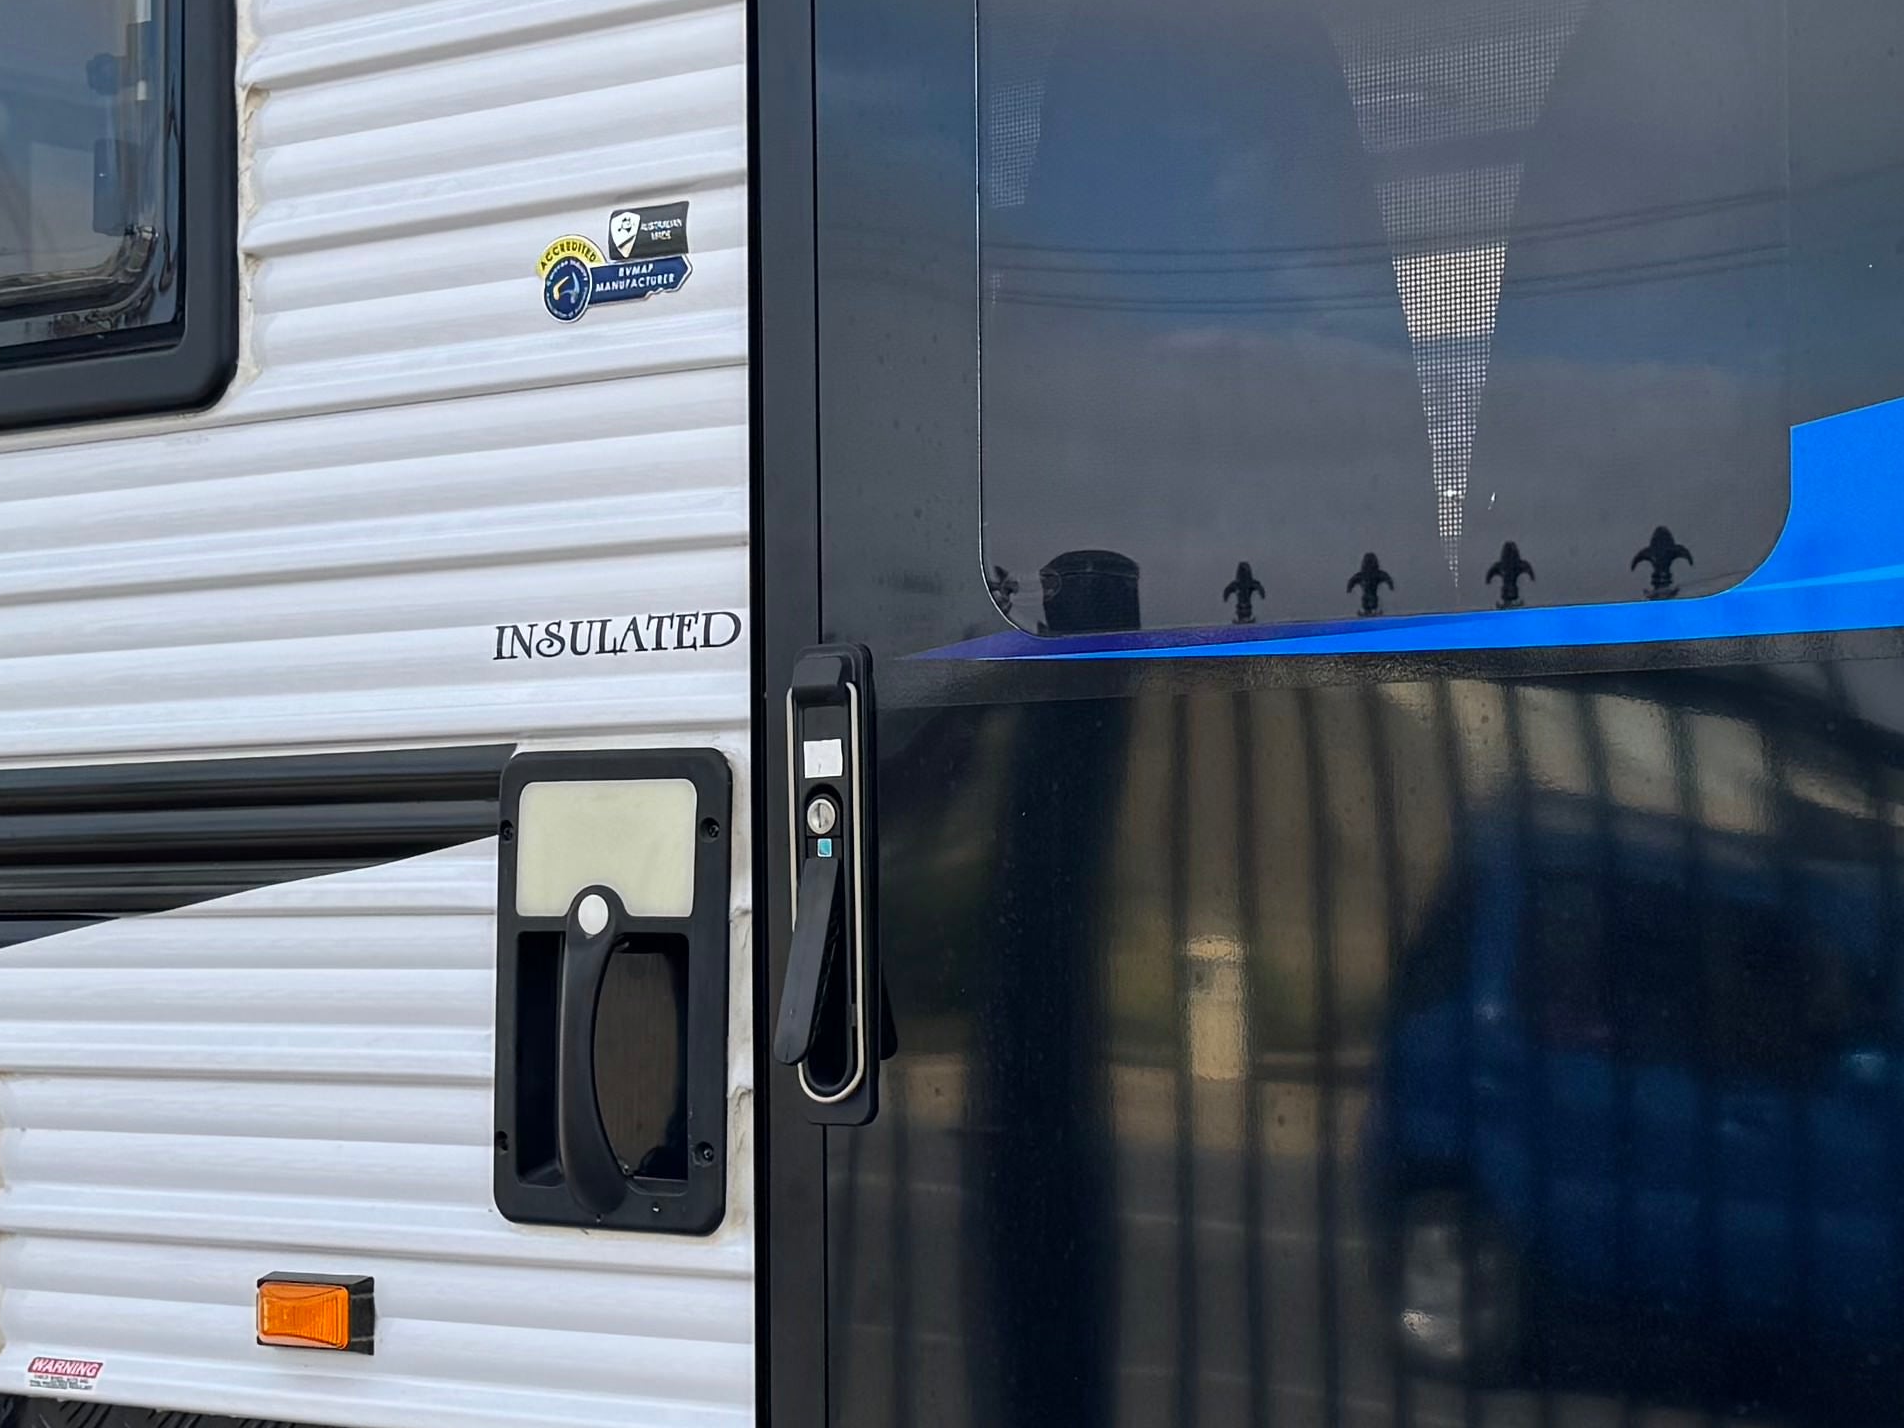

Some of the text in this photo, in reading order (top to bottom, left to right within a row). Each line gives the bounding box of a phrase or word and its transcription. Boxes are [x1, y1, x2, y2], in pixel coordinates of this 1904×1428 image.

[540, 241, 597, 271] ACCREDITED
[595, 273, 676, 293] MANUFACTURER
[492, 610, 743, 661] INSULATED
[32, 1358, 100, 1377] WARNING
